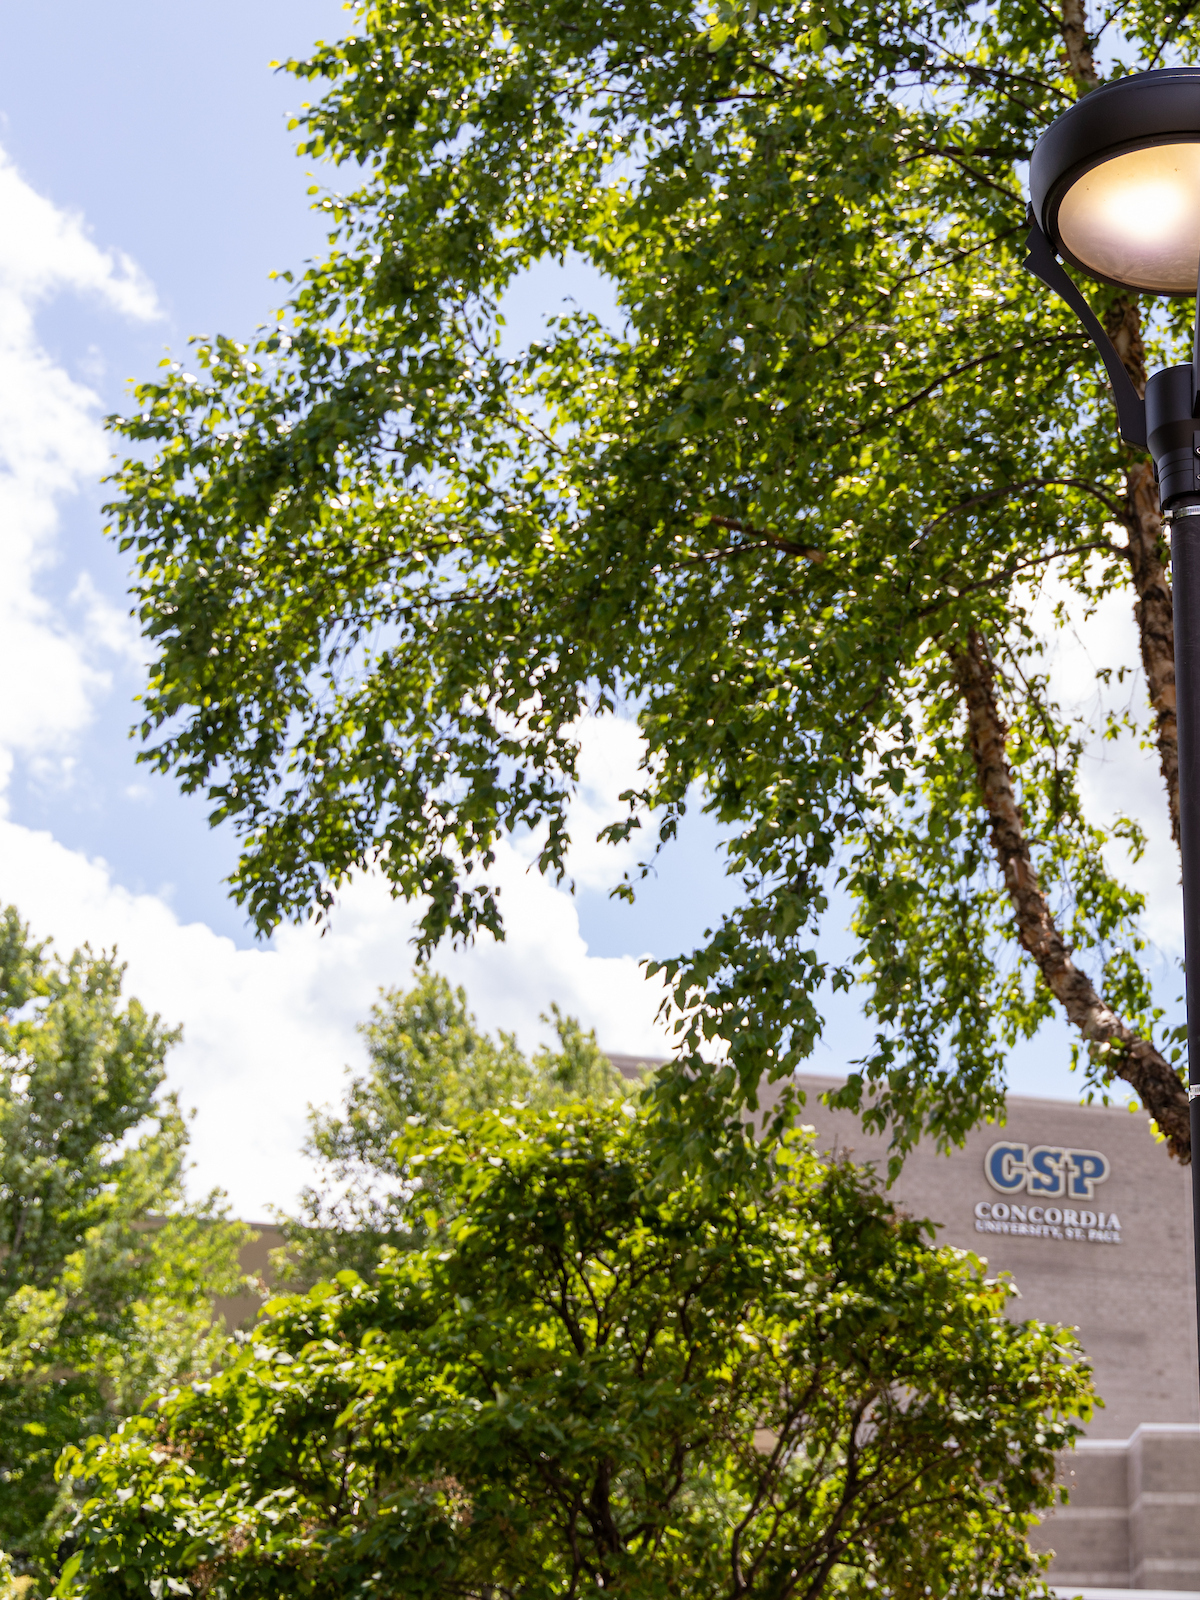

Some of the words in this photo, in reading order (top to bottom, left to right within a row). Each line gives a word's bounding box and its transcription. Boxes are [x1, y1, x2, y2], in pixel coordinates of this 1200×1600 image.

[984, 1141, 1111, 1200] CSP
[975, 1201, 1122, 1230] CONCORDIA
[975, 1220, 1063, 1240] UNIVERSITY,
[1065, 1227, 1086, 1241] ST.
[1088, 1229, 1121, 1244] PAUL
